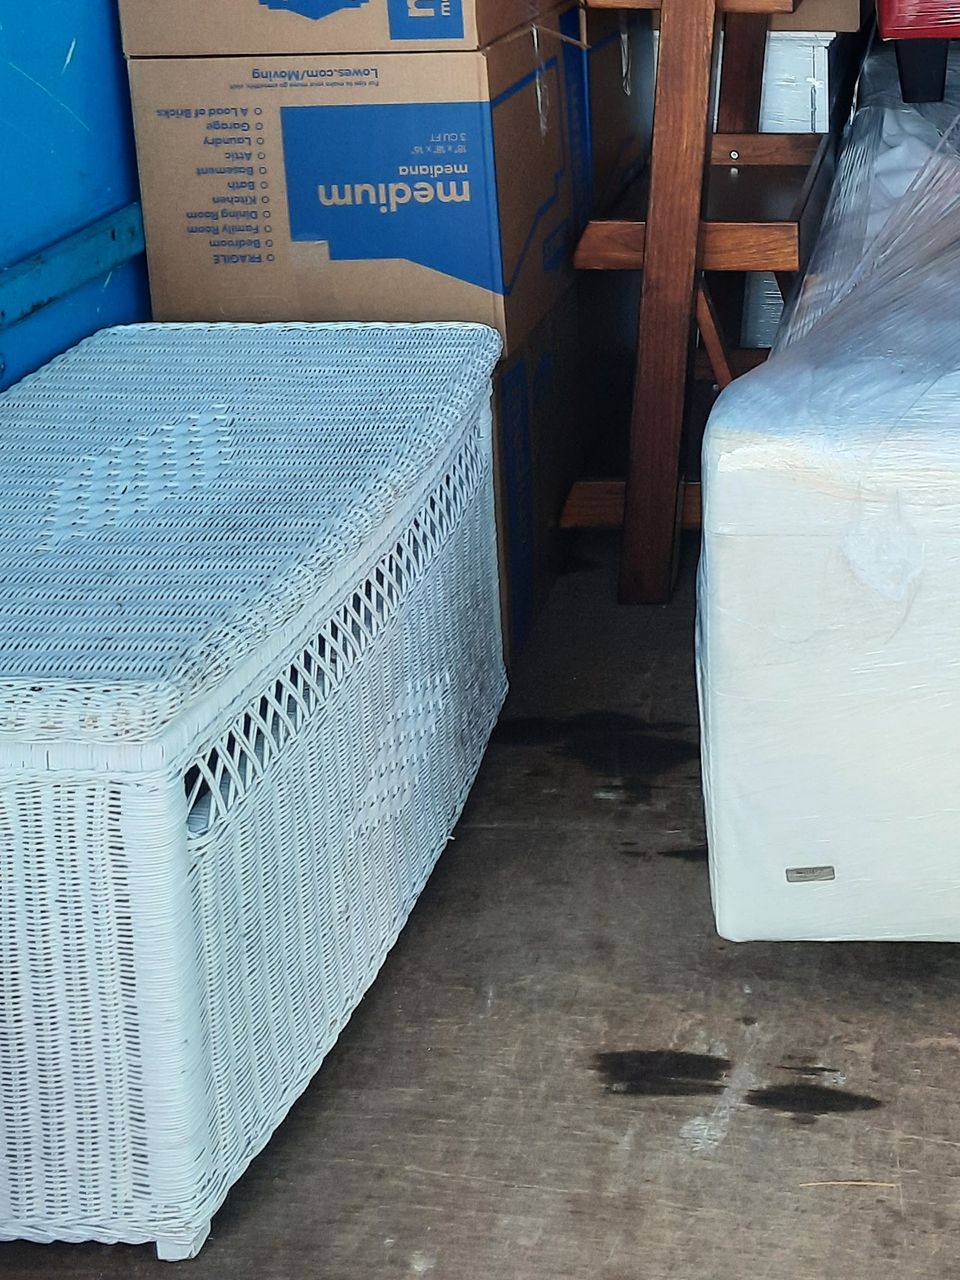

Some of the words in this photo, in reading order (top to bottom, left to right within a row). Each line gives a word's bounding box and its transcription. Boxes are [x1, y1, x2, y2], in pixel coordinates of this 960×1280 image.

[252, 68, 378, 81] Lowes.com/Moving
[157, 109, 192, 118] Bricks
[194, 109, 206, 117] of
[208, 108, 238, 117] Load
[240, 108, 248, 116] A
[206, 122, 250, 131] Garage
[203, 137, 251, 146] Laundry
[430, 134, 441, 142] FT
[461, 133, 466, 141] 3
[225, 152, 252, 160] Attic
[197, 167, 254, 176] Basement
[399, 164, 468, 178] mediana
[228, 182, 255, 190] Bath
[213, 196, 257, 205] Kitchen
[318, 180, 470, 214] medium
[186, 211, 219, 220] Room
[221, 209, 258, 220] Dining
[187, 226, 219, 235] Room
[223, 225, 259, 234] Family
[209, 239, 261, 248] Bedroom
[213, 254, 262, 264] FRAGILE
